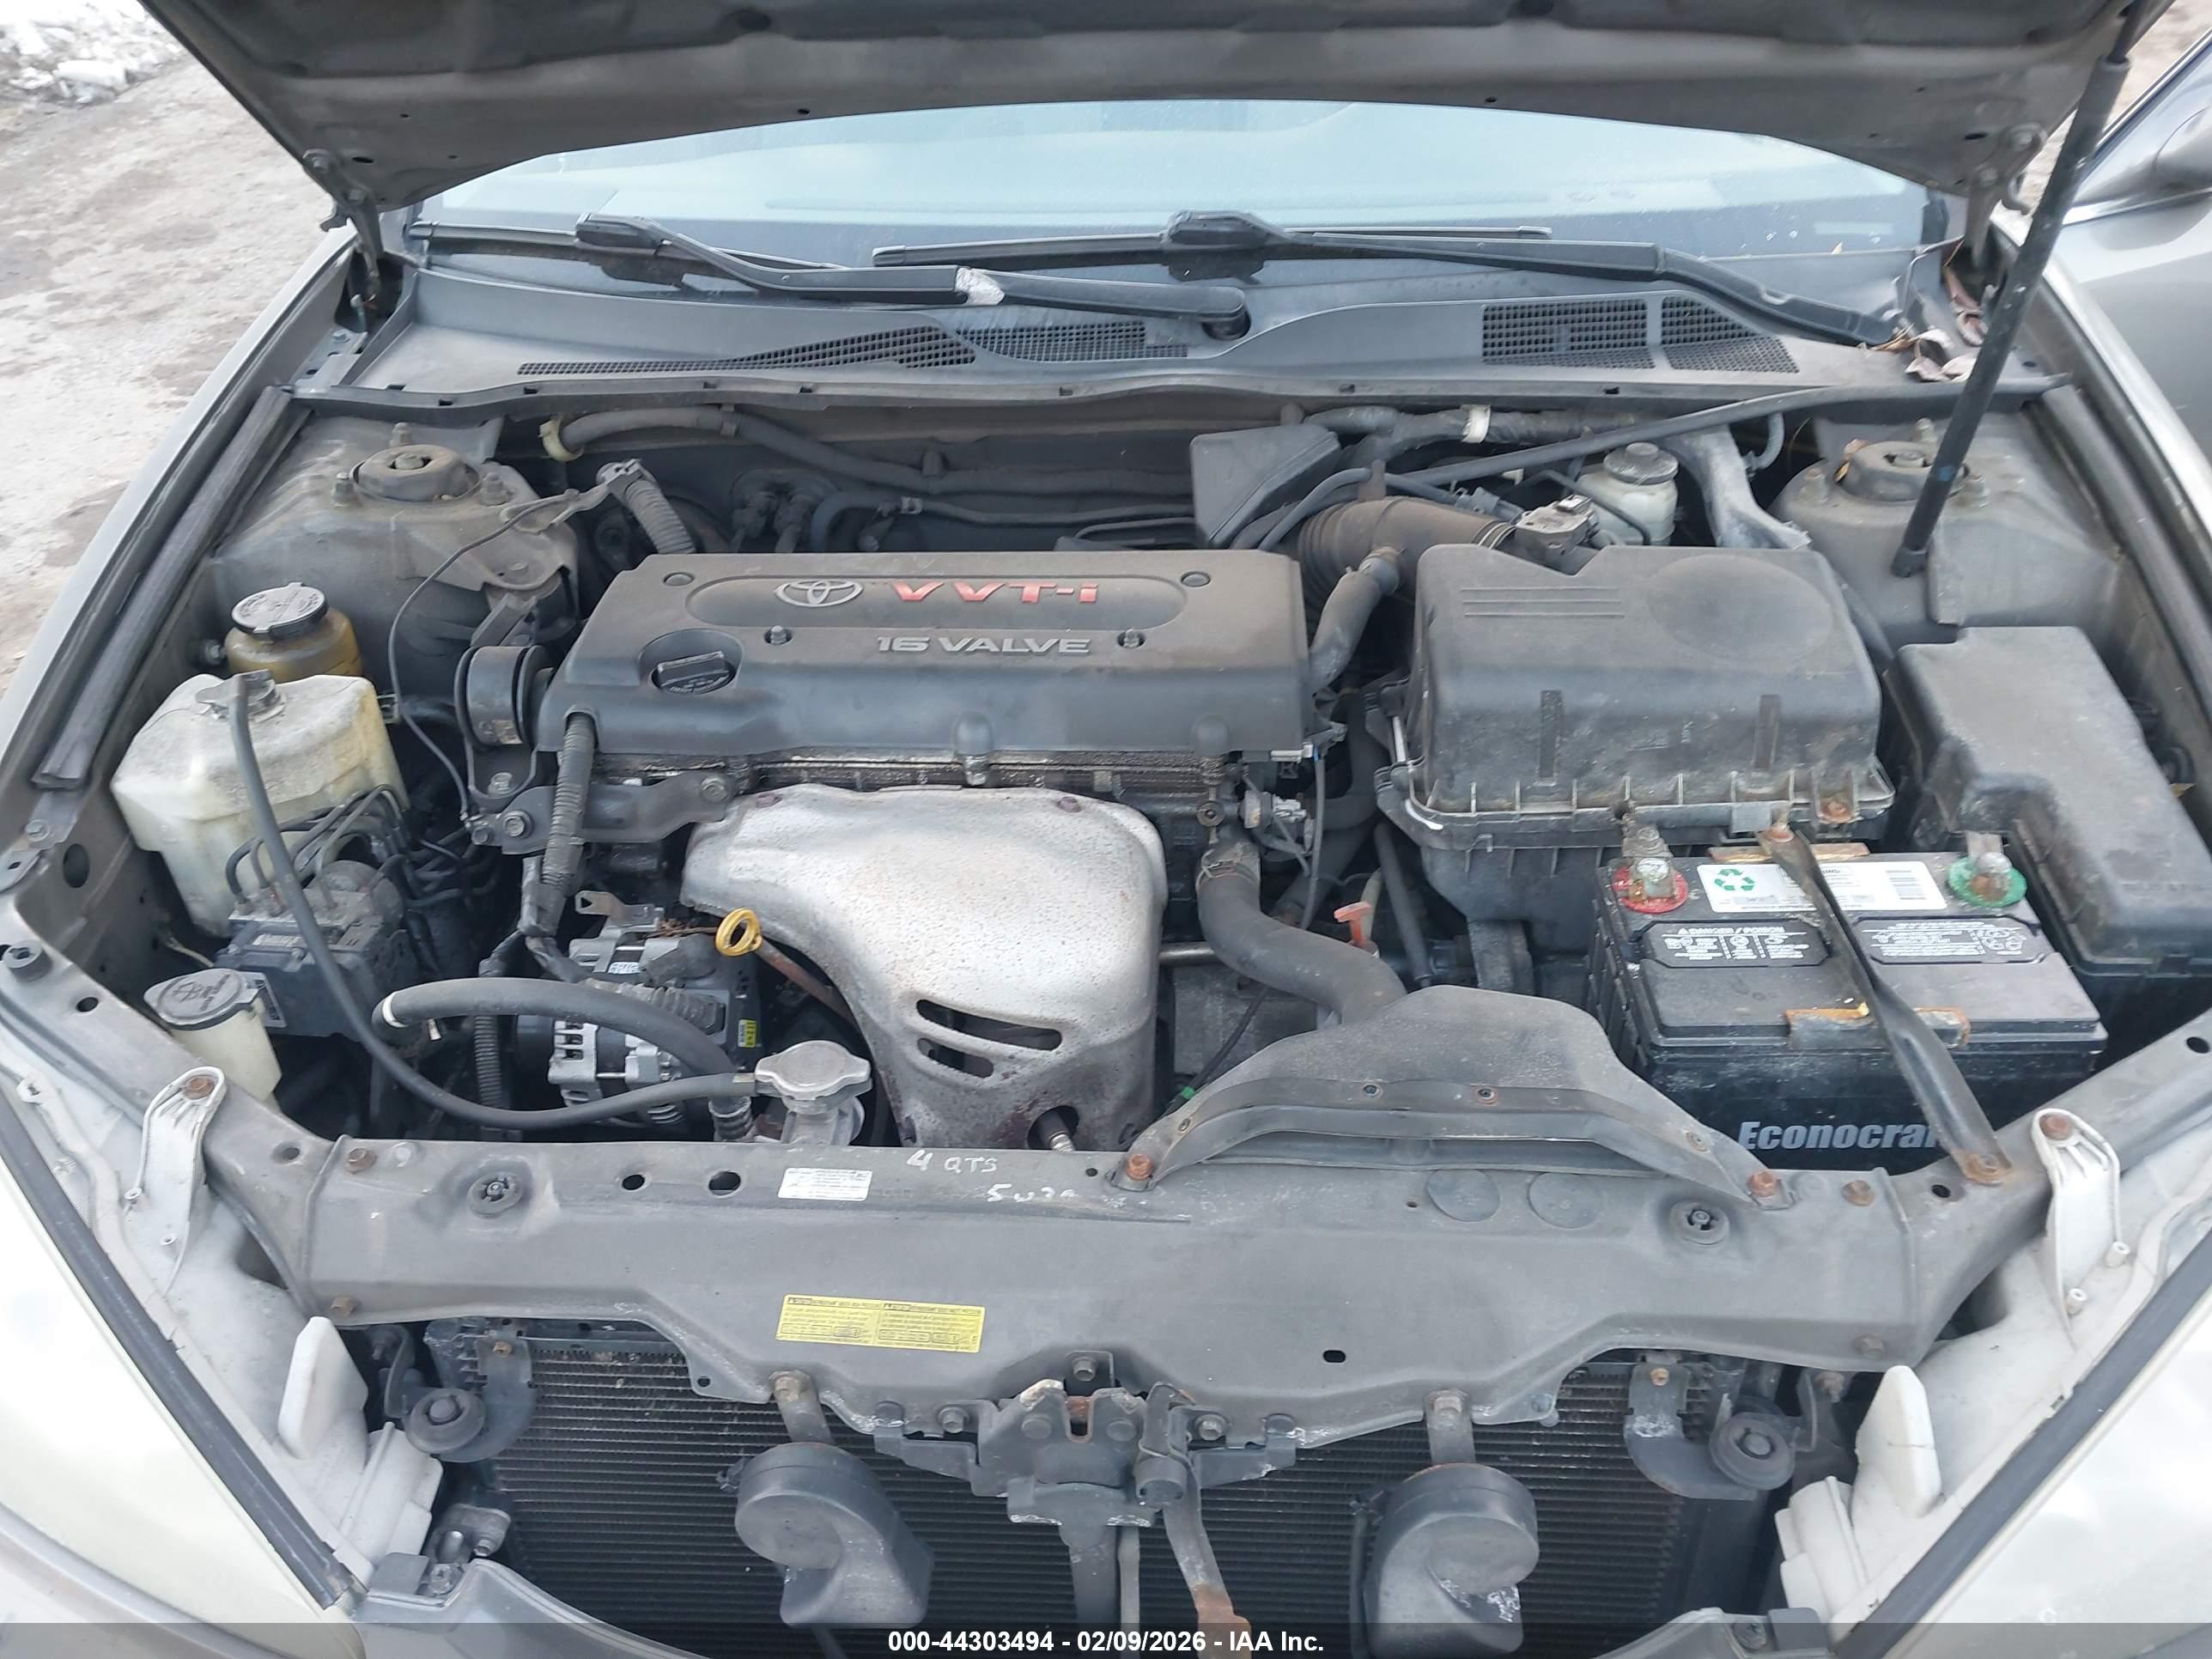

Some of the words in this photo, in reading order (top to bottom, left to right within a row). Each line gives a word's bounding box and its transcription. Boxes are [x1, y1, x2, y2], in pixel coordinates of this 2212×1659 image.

[893, 581, 1099, 603] VVT-i
[878, 636, 930, 651] 16
[939, 637, 1090, 653] VALVE
[906, 1149, 933, 1171] 4
[944, 1157, 997, 1174] QTS
